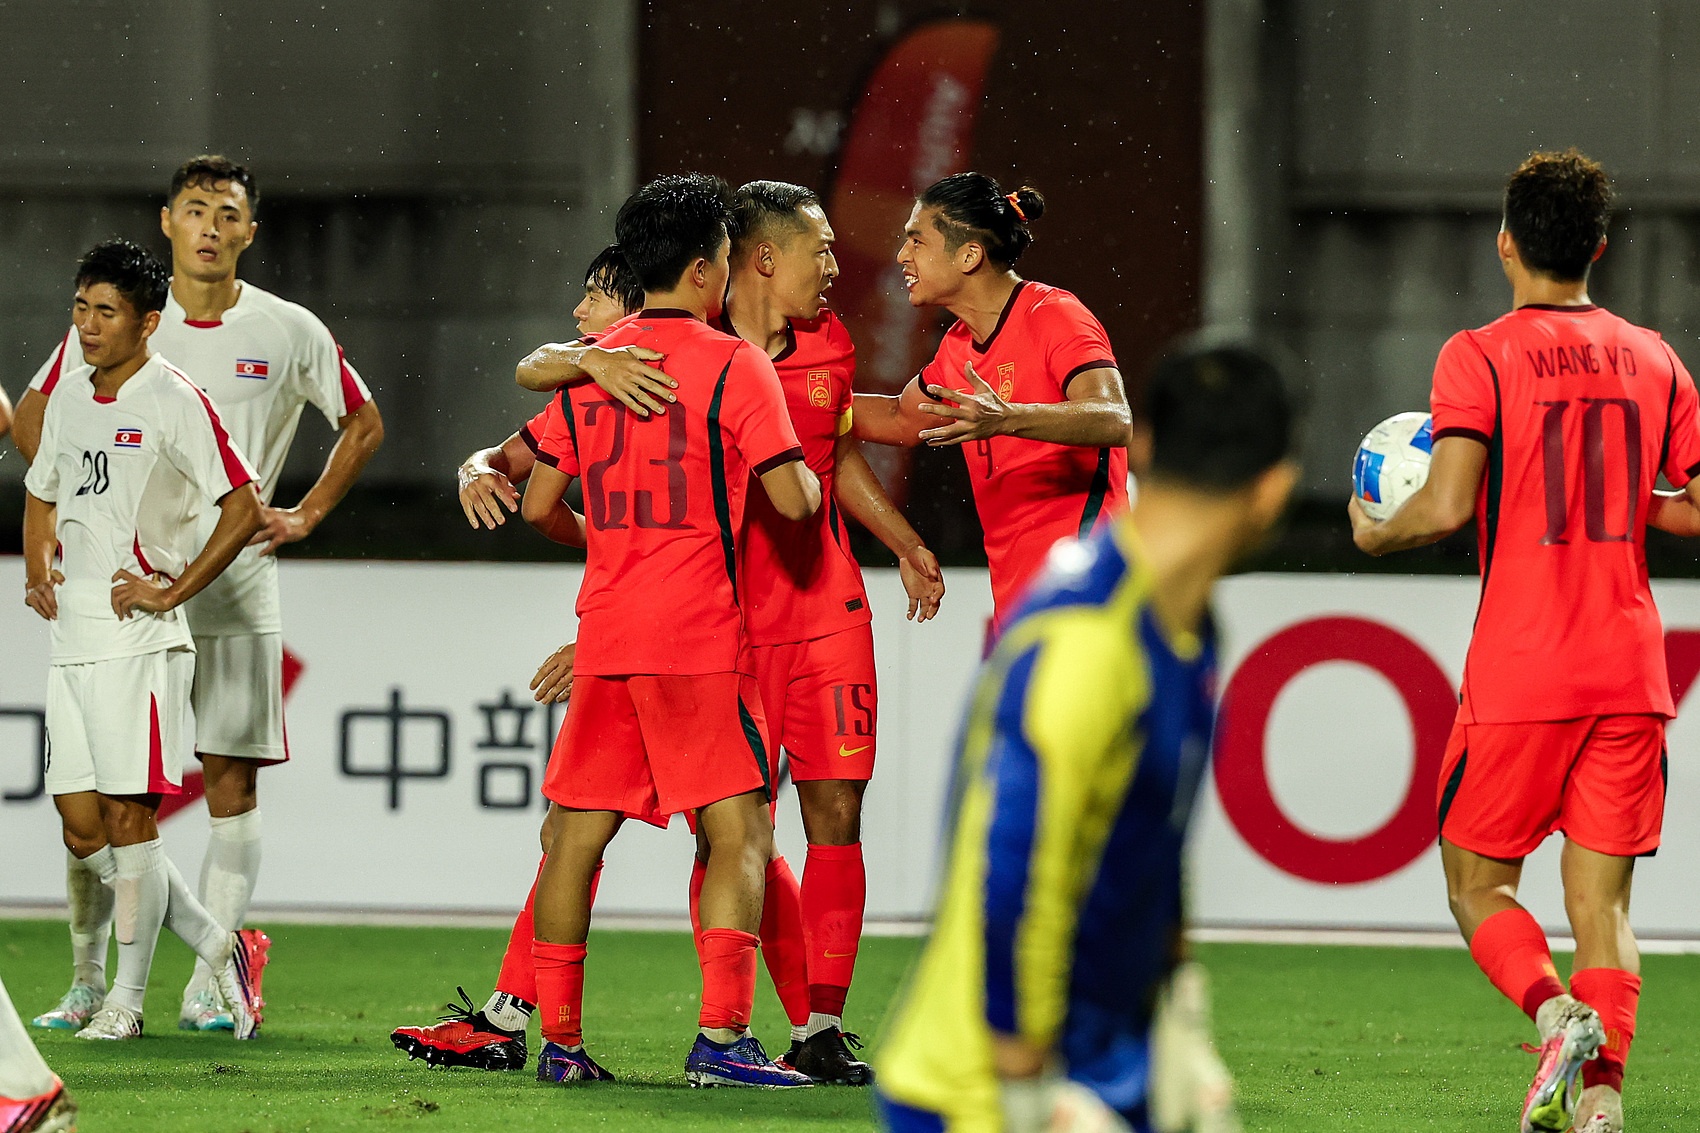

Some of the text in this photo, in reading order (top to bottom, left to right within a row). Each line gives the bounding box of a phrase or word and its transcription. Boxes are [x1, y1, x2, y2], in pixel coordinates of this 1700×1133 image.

[1526, 343, 1600, 378] WANG
[75, 450, 110, 497] 20
[578, 400, 698, 532] 23
[1533, 398, 1642, 545] 10
